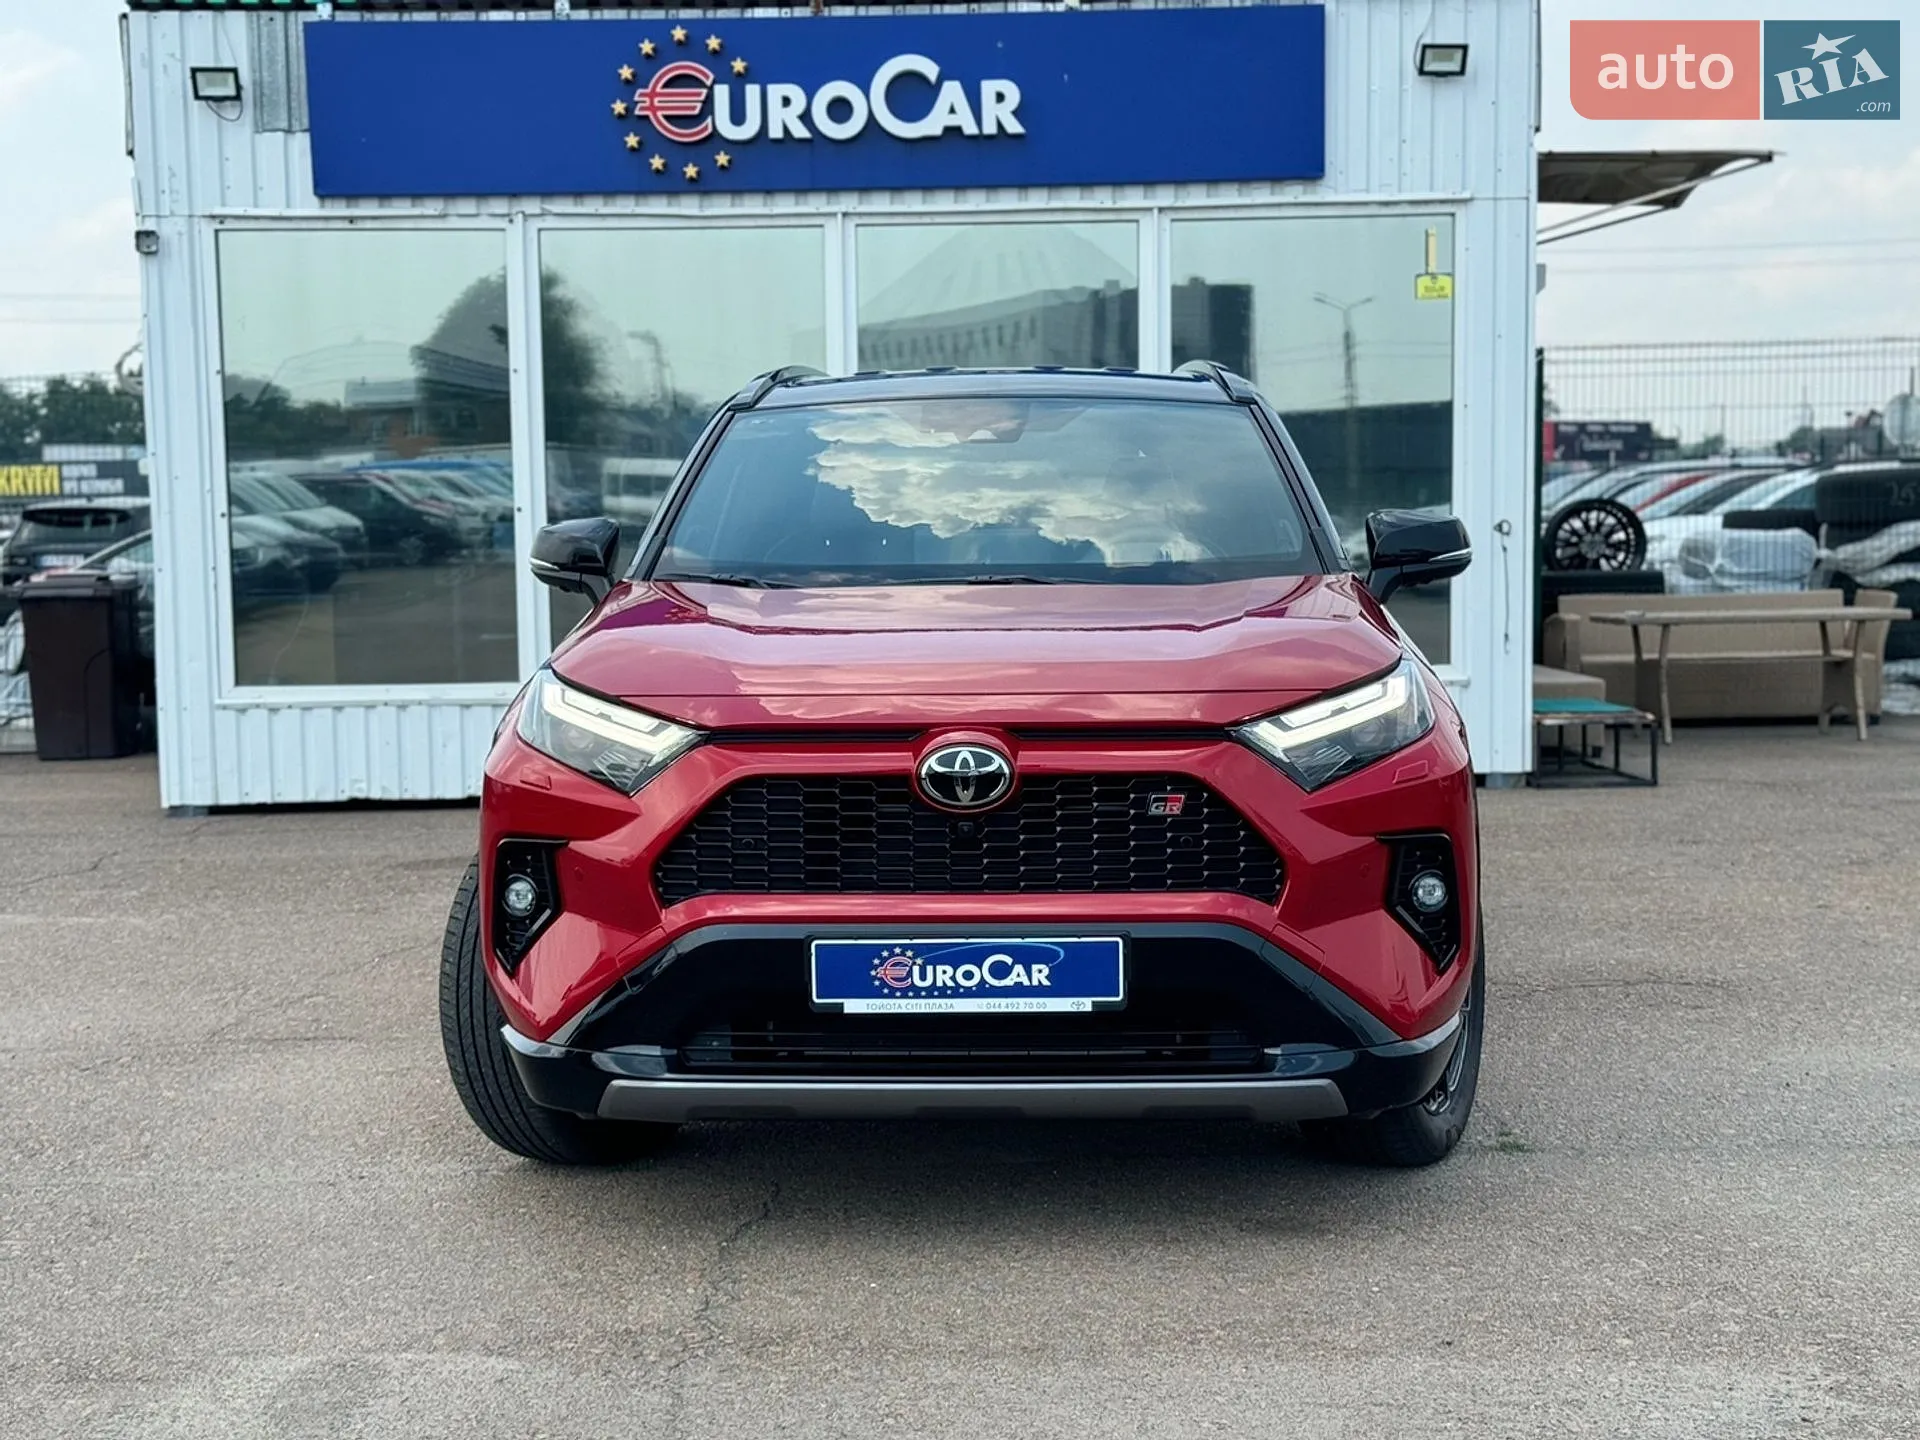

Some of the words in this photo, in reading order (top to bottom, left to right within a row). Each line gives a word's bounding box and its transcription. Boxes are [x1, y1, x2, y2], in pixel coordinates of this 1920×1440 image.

[1149, 800, 1183, 815] GR
[866, 1002, 902, 1011] ТОЙОТА
[924, 1002, 955, 1011] ПЛАЗА
[986, 1001, 1002, 1010] 044
[1004, 1001, 1020, 1010] 492
[1035, 1001, 1048, 1010] 00
